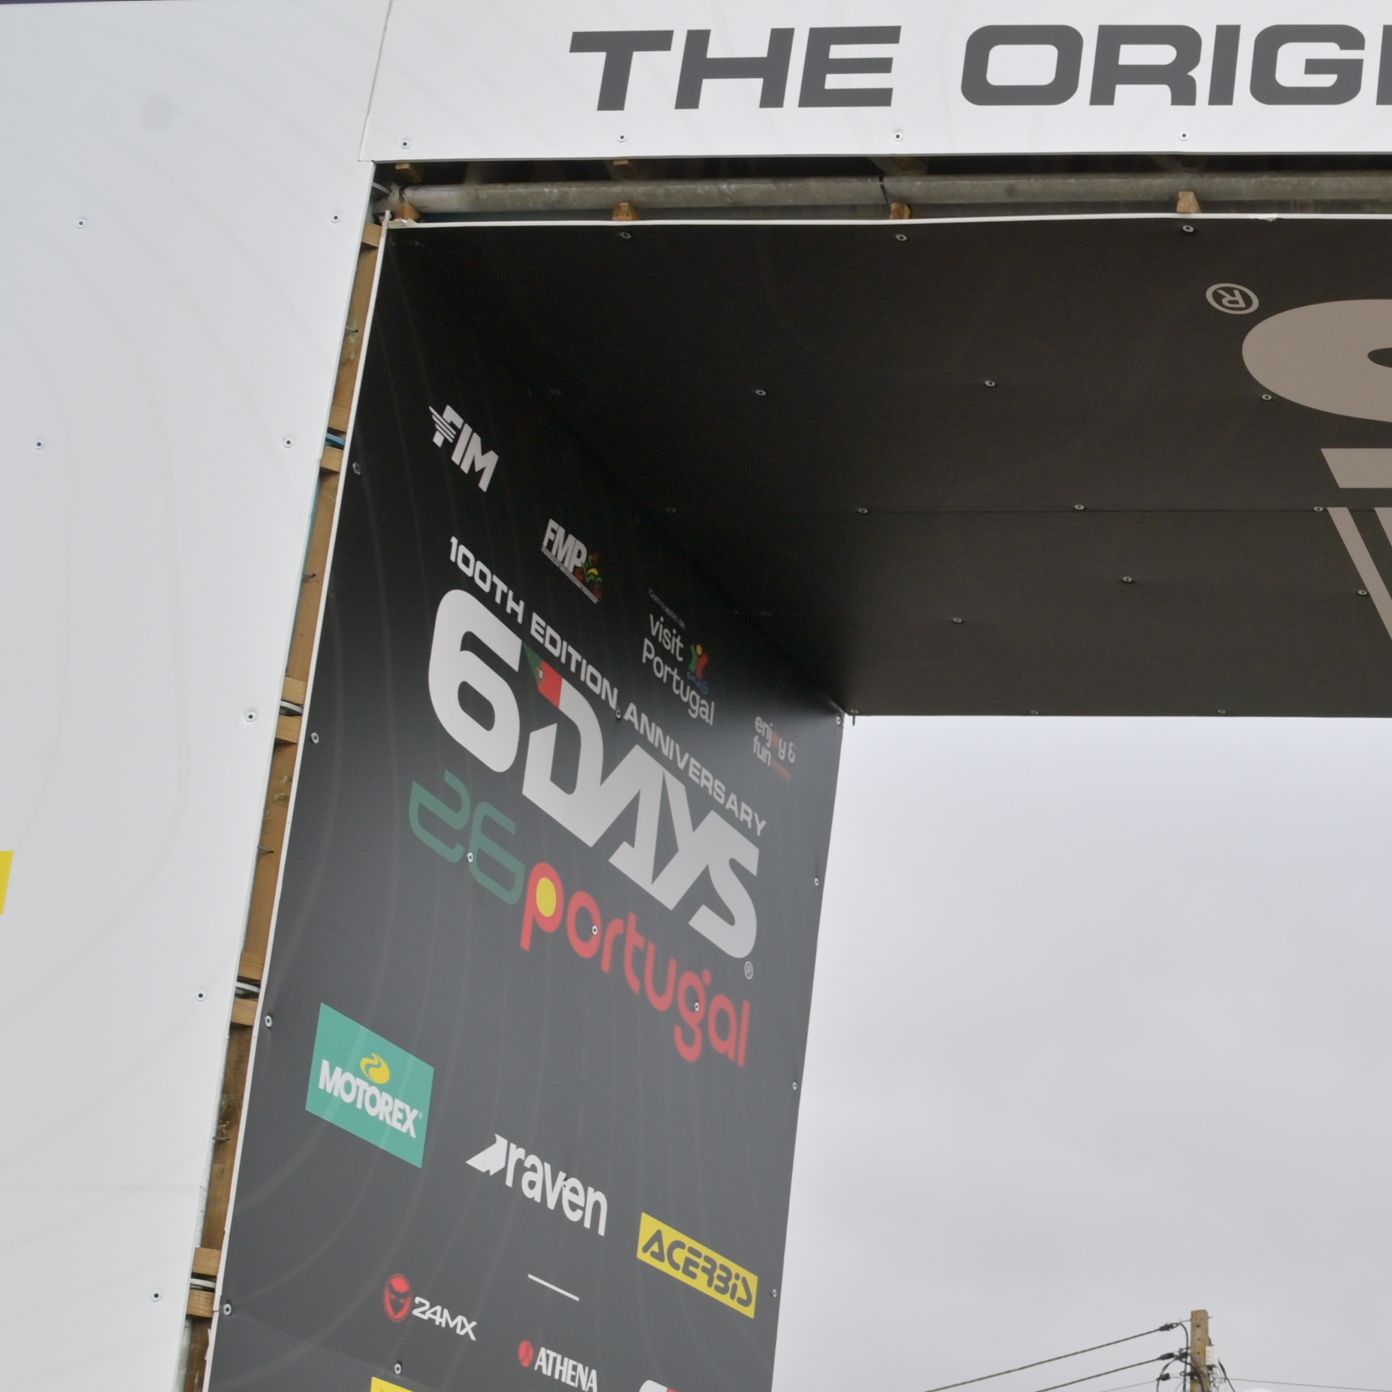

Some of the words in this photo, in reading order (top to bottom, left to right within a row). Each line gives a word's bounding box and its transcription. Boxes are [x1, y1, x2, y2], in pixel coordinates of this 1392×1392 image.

[569, 28, 902, 111] THE
[429, 405, 499, 492] FIM
[650, 614, 683, 662] visit
[450, 536, 525, 624] 100TH
[530, 612, 618, 710] EDITION
[624, 702, 767, 837] ANNIVERSARY
[642, 637, 714, 726] Portugal
[318, 1059, 417, 1138] MOTOREX
[505, 1142, 608, 1236] raven
[412, 1297, 477, 1341] 24MX
